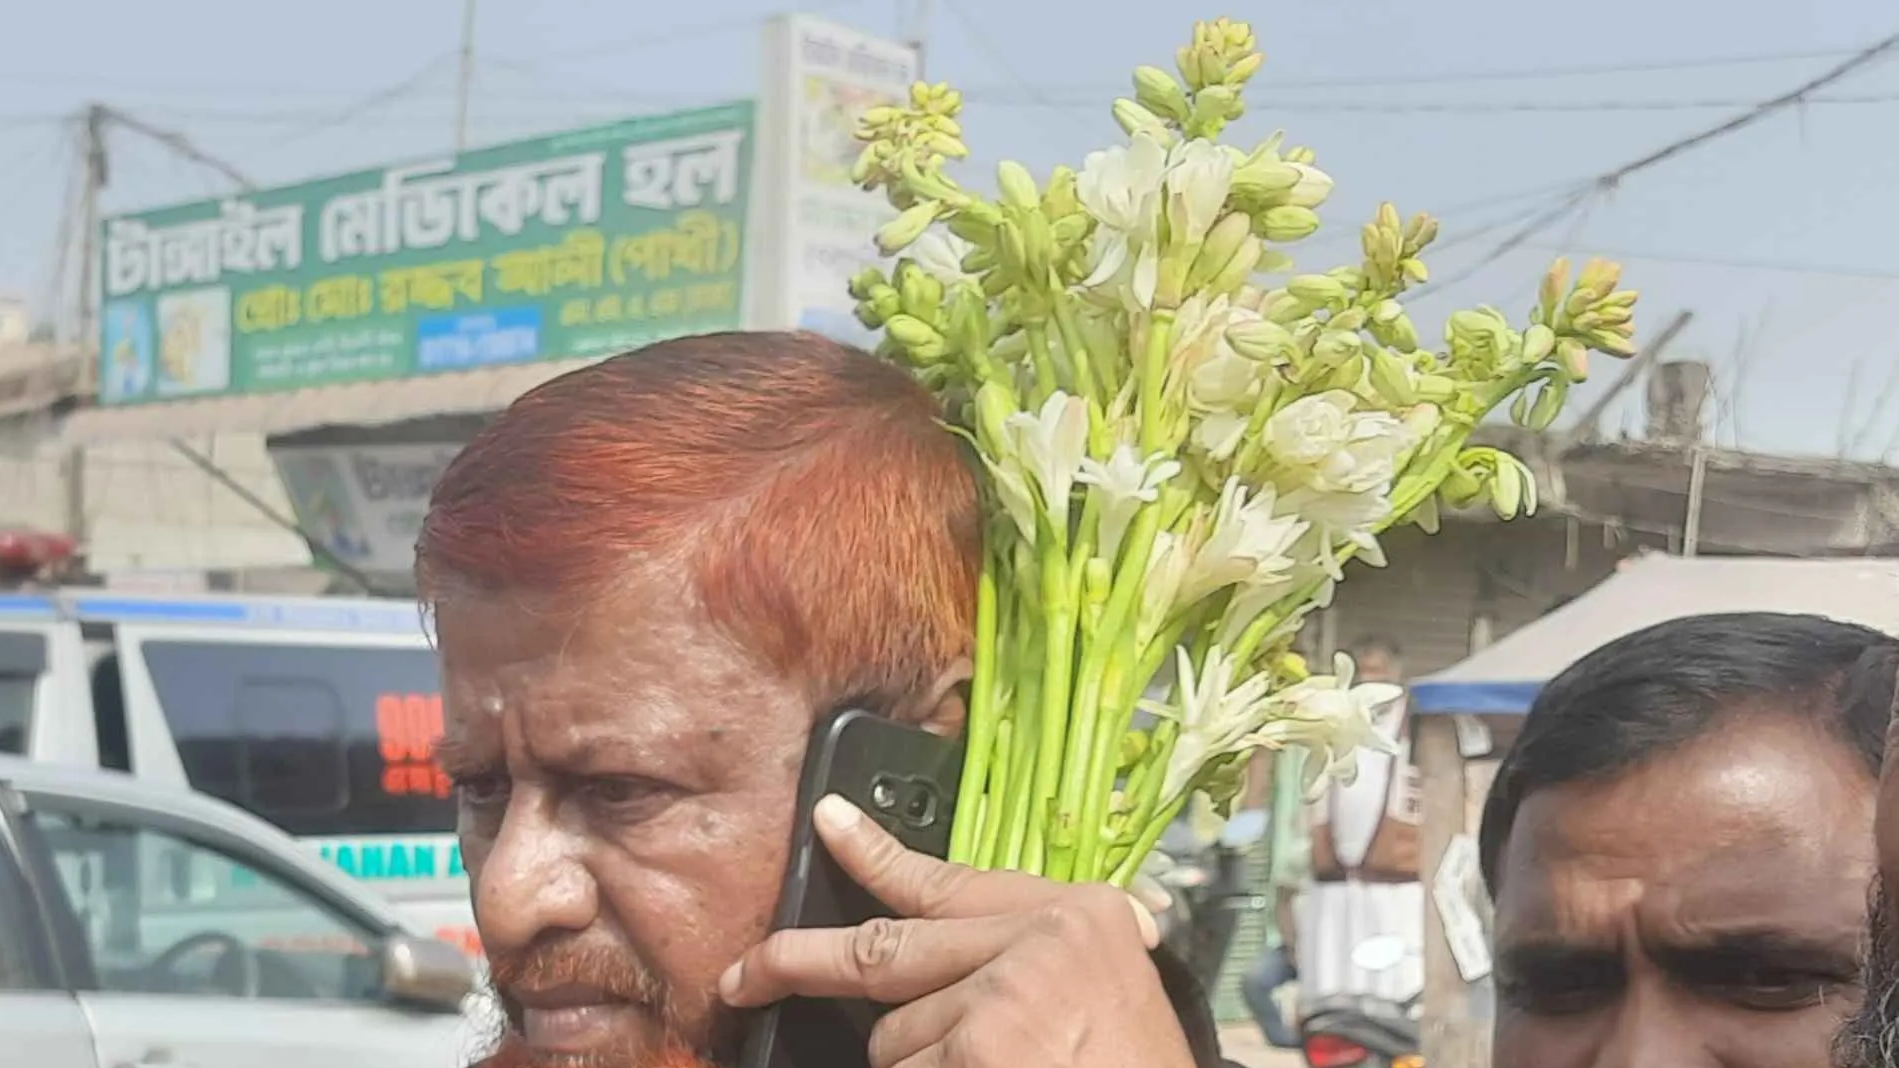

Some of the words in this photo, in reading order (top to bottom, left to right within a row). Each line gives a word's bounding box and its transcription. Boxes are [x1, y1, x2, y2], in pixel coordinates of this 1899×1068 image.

[320, 151, 604, 264] মেডিকেল
[621, 128, 743, 210] হল
[320, 843, 437, 879] AHAN
